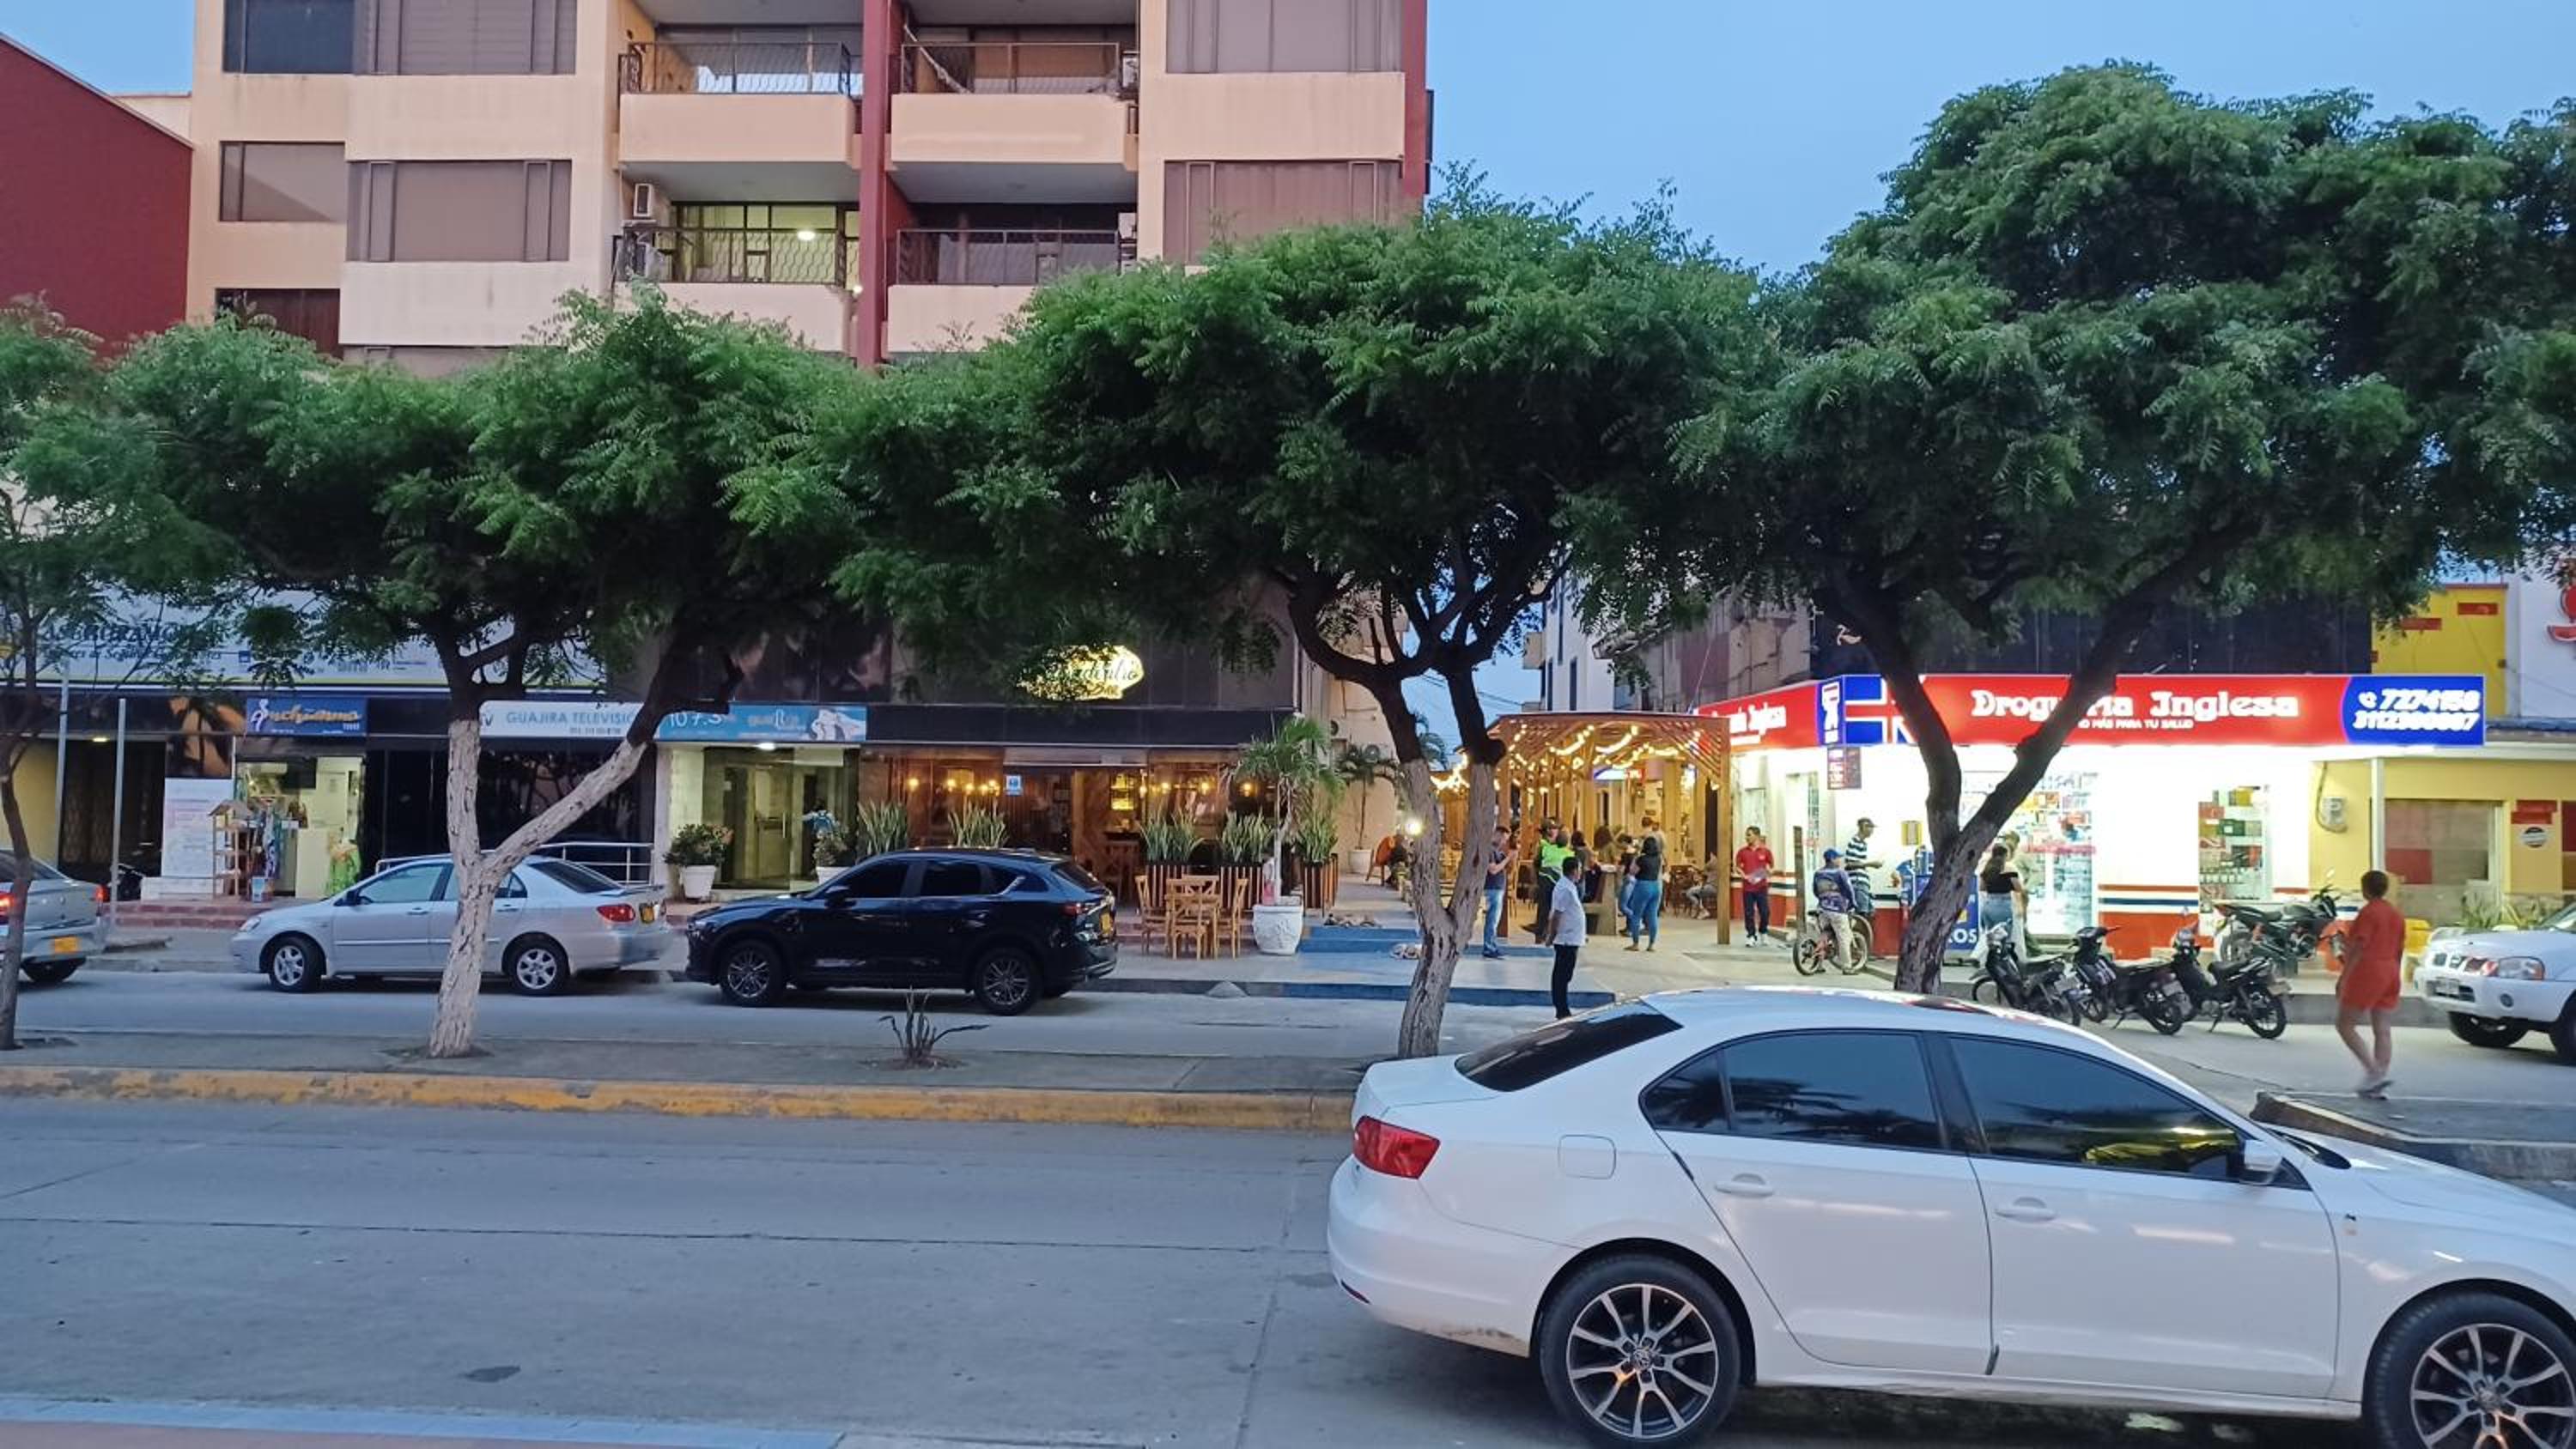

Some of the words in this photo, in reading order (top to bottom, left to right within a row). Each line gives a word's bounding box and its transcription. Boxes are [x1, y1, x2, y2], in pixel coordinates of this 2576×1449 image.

[2150, 691, 2300, 721] Inglesa
[506, 712, 568, 724] GUAJIRA
[572, 711, 634, 724] TELEVISI
[2145, 719, 2159, 729] TU
[2161, 719, 2194, 729] SALUD
